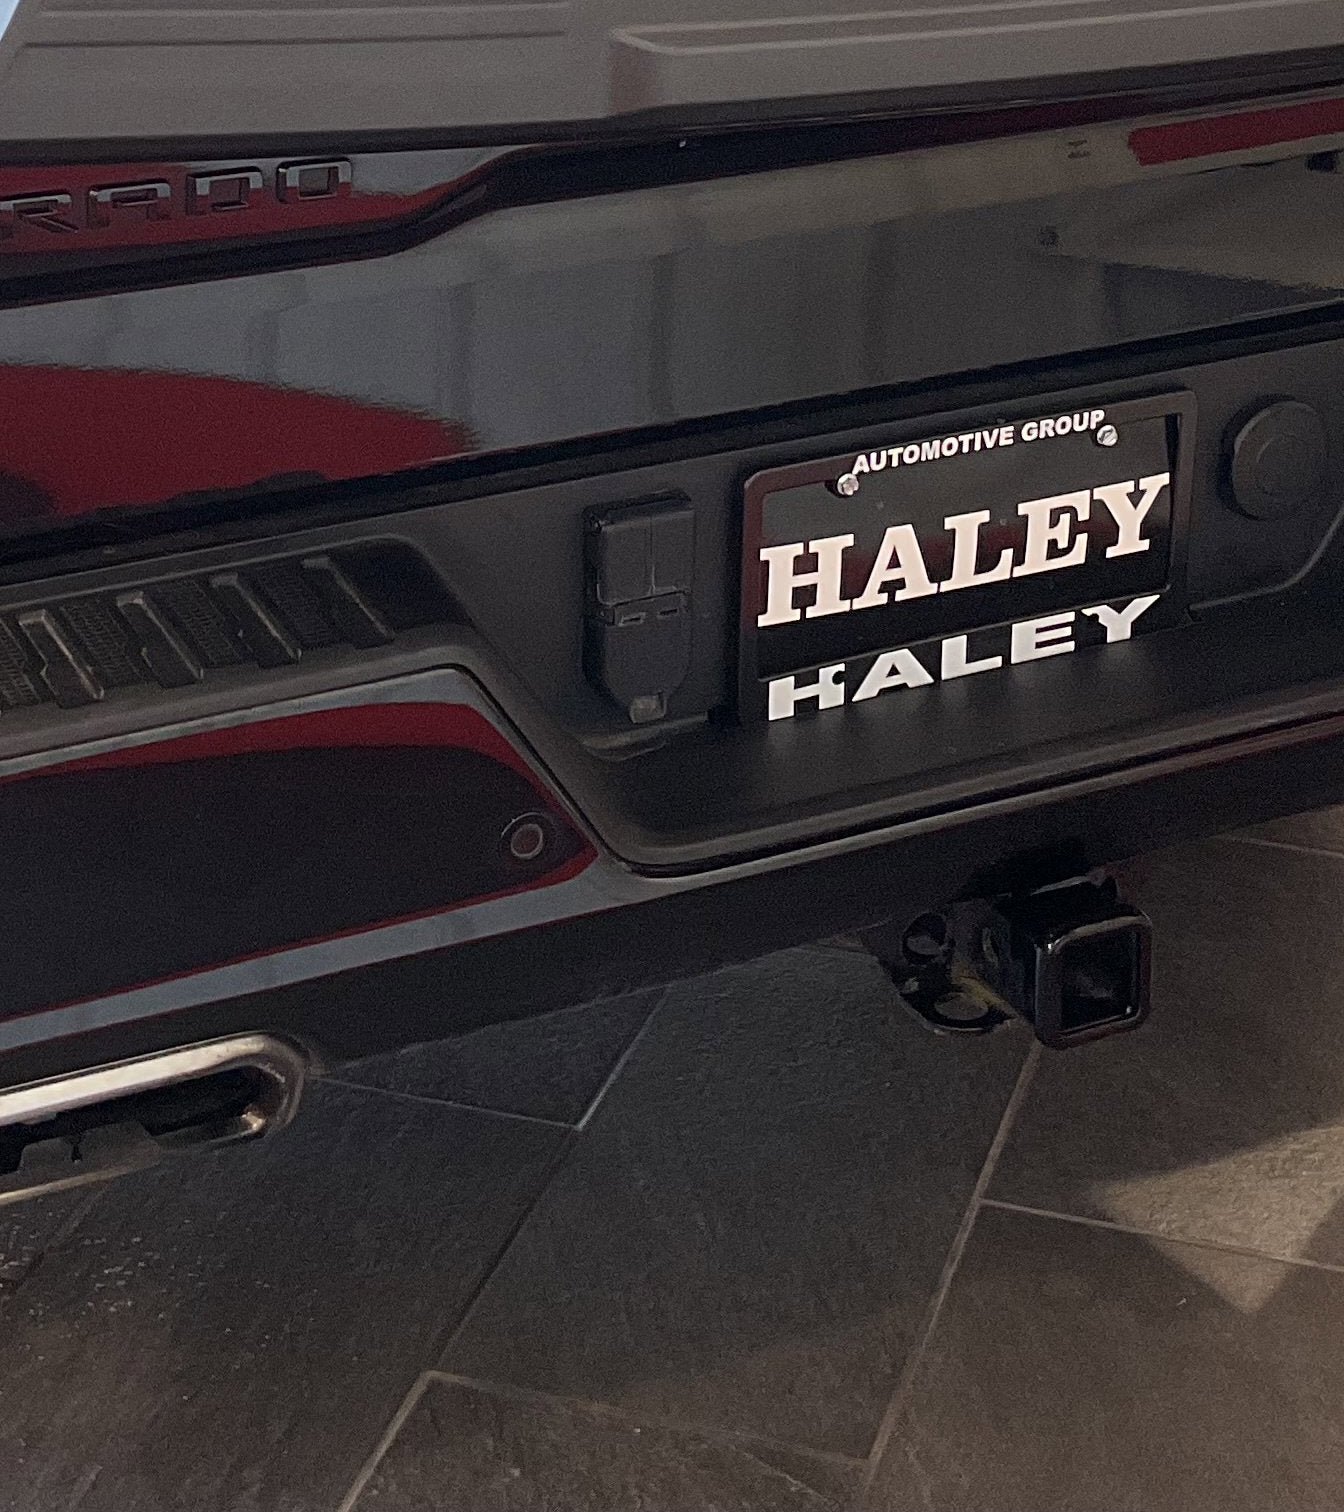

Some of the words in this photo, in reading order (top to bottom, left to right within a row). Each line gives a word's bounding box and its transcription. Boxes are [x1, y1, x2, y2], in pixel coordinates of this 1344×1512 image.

[851, 426, 1015, 475] AUTOMOTIVE
[1021, 409, 1105, 442] GROUP
[756, 471, 1170, 627] HALEY
[767, 594, 1161, 721] HALEY
